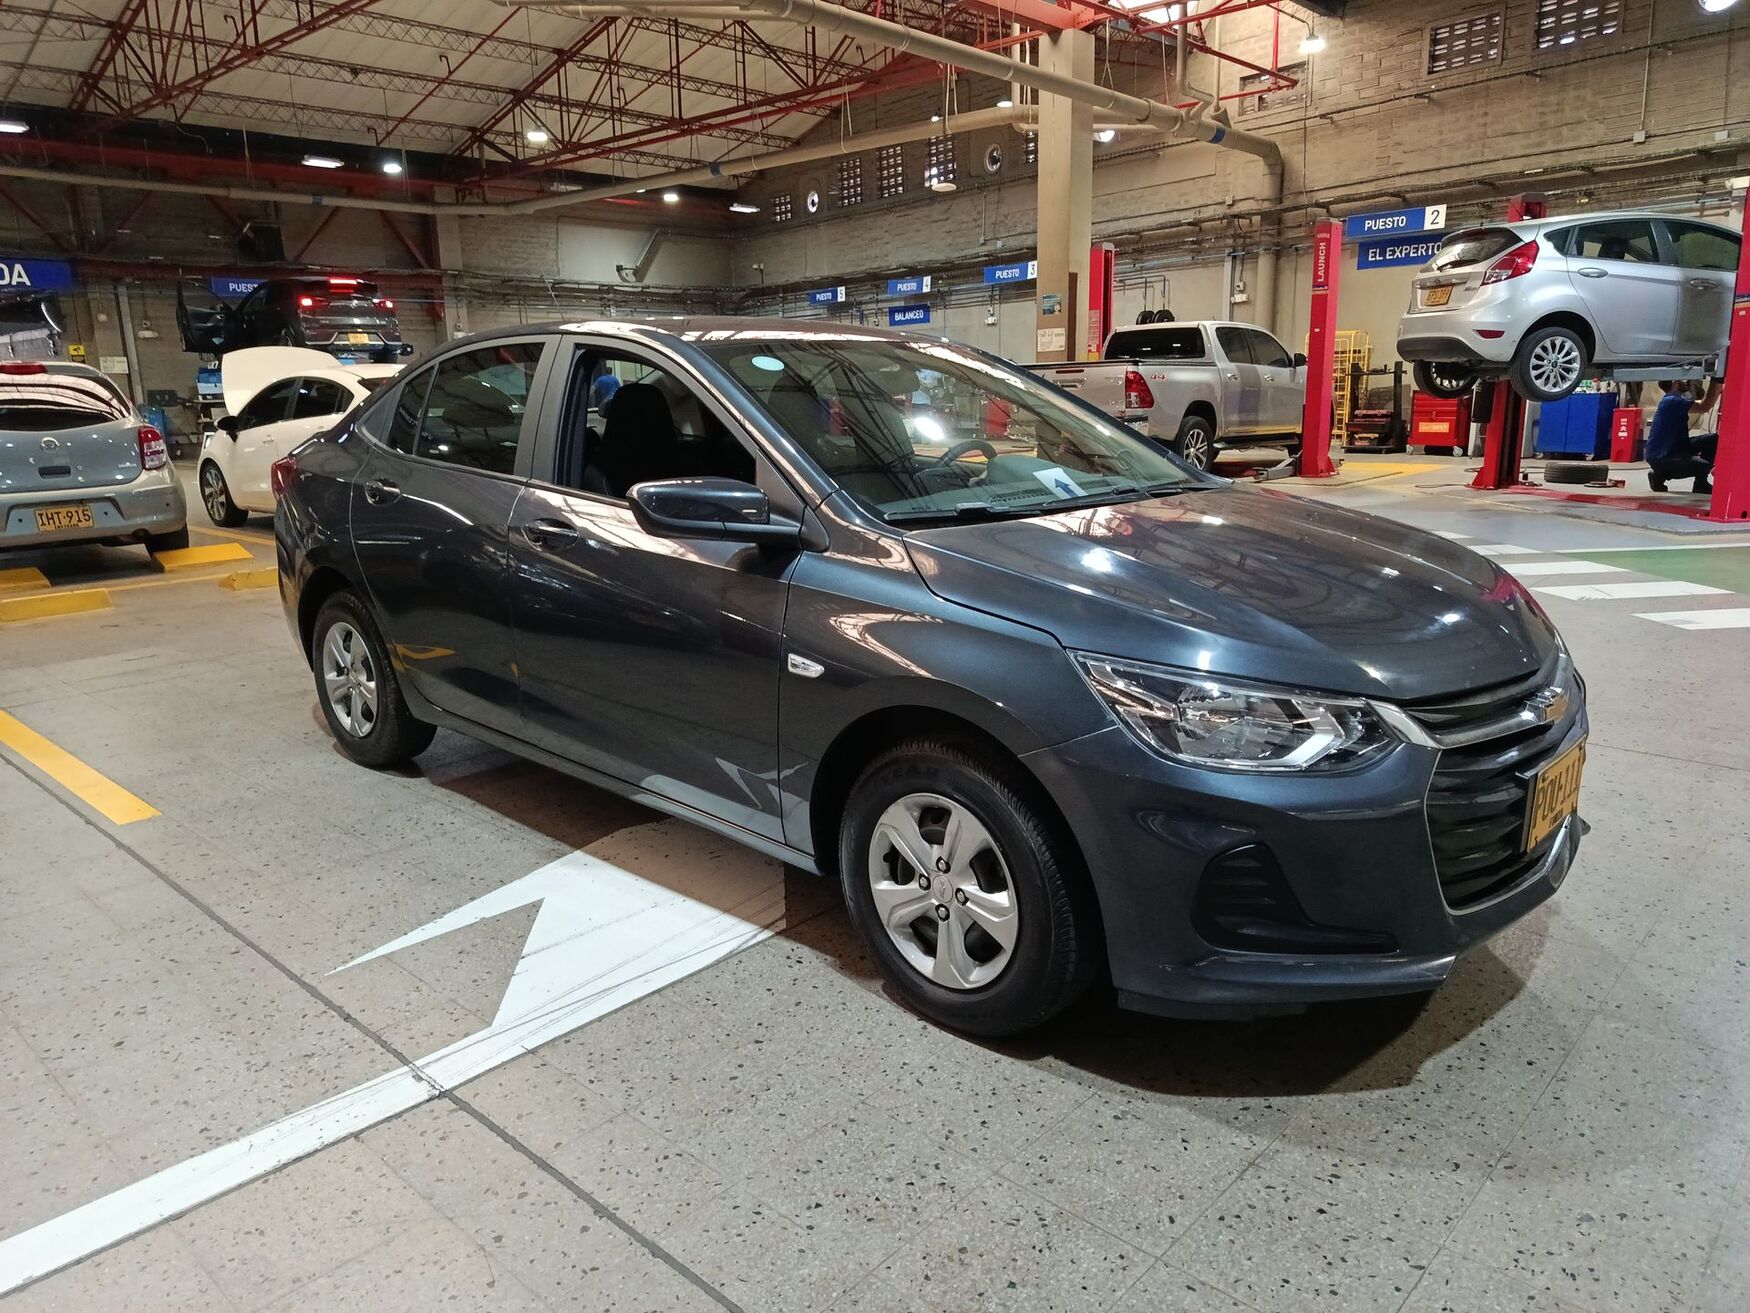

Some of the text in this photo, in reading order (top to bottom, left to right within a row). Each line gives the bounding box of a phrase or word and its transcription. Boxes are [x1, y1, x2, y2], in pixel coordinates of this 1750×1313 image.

[1365, 210, 1440, 231] PUESTO 2
[1368, 242, 1441, 261] EL EXPERTO
[1317, 242, 1326, 282] LAUNCH
[995, 263, 1036, 279] PUESTO 3
[839, 289, 844, 299] 5
[896, 282, 917, 291] PUESTO
[895, 310, 924, 321] BALANCEO
